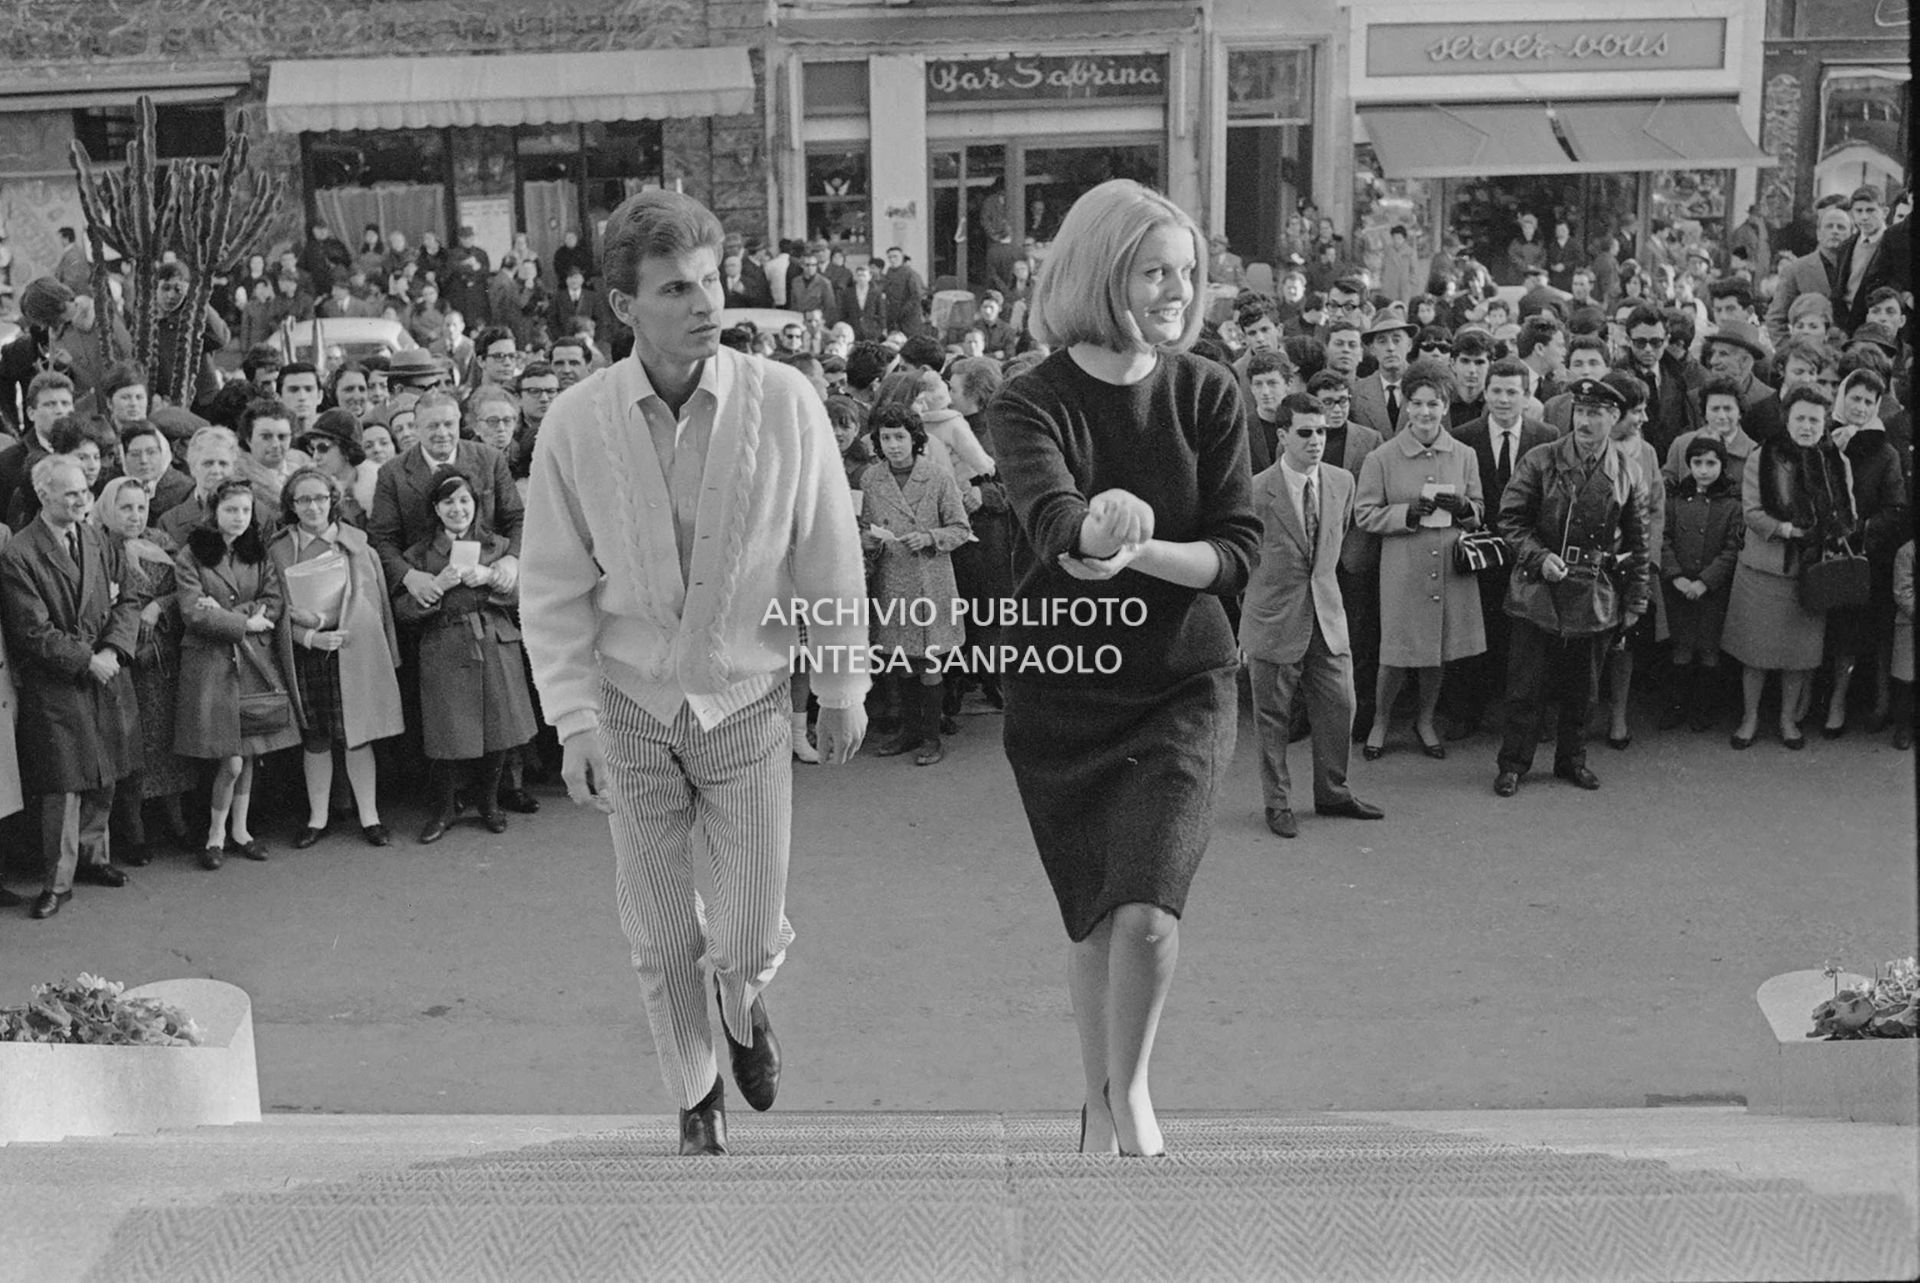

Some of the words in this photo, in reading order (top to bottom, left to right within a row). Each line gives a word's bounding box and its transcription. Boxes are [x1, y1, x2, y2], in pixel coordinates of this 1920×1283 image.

[1568, 33, 1668, 58] vous
[929, 63, 1004, 92] Bar
[1009, 59, 1161, 89] Sabrina
